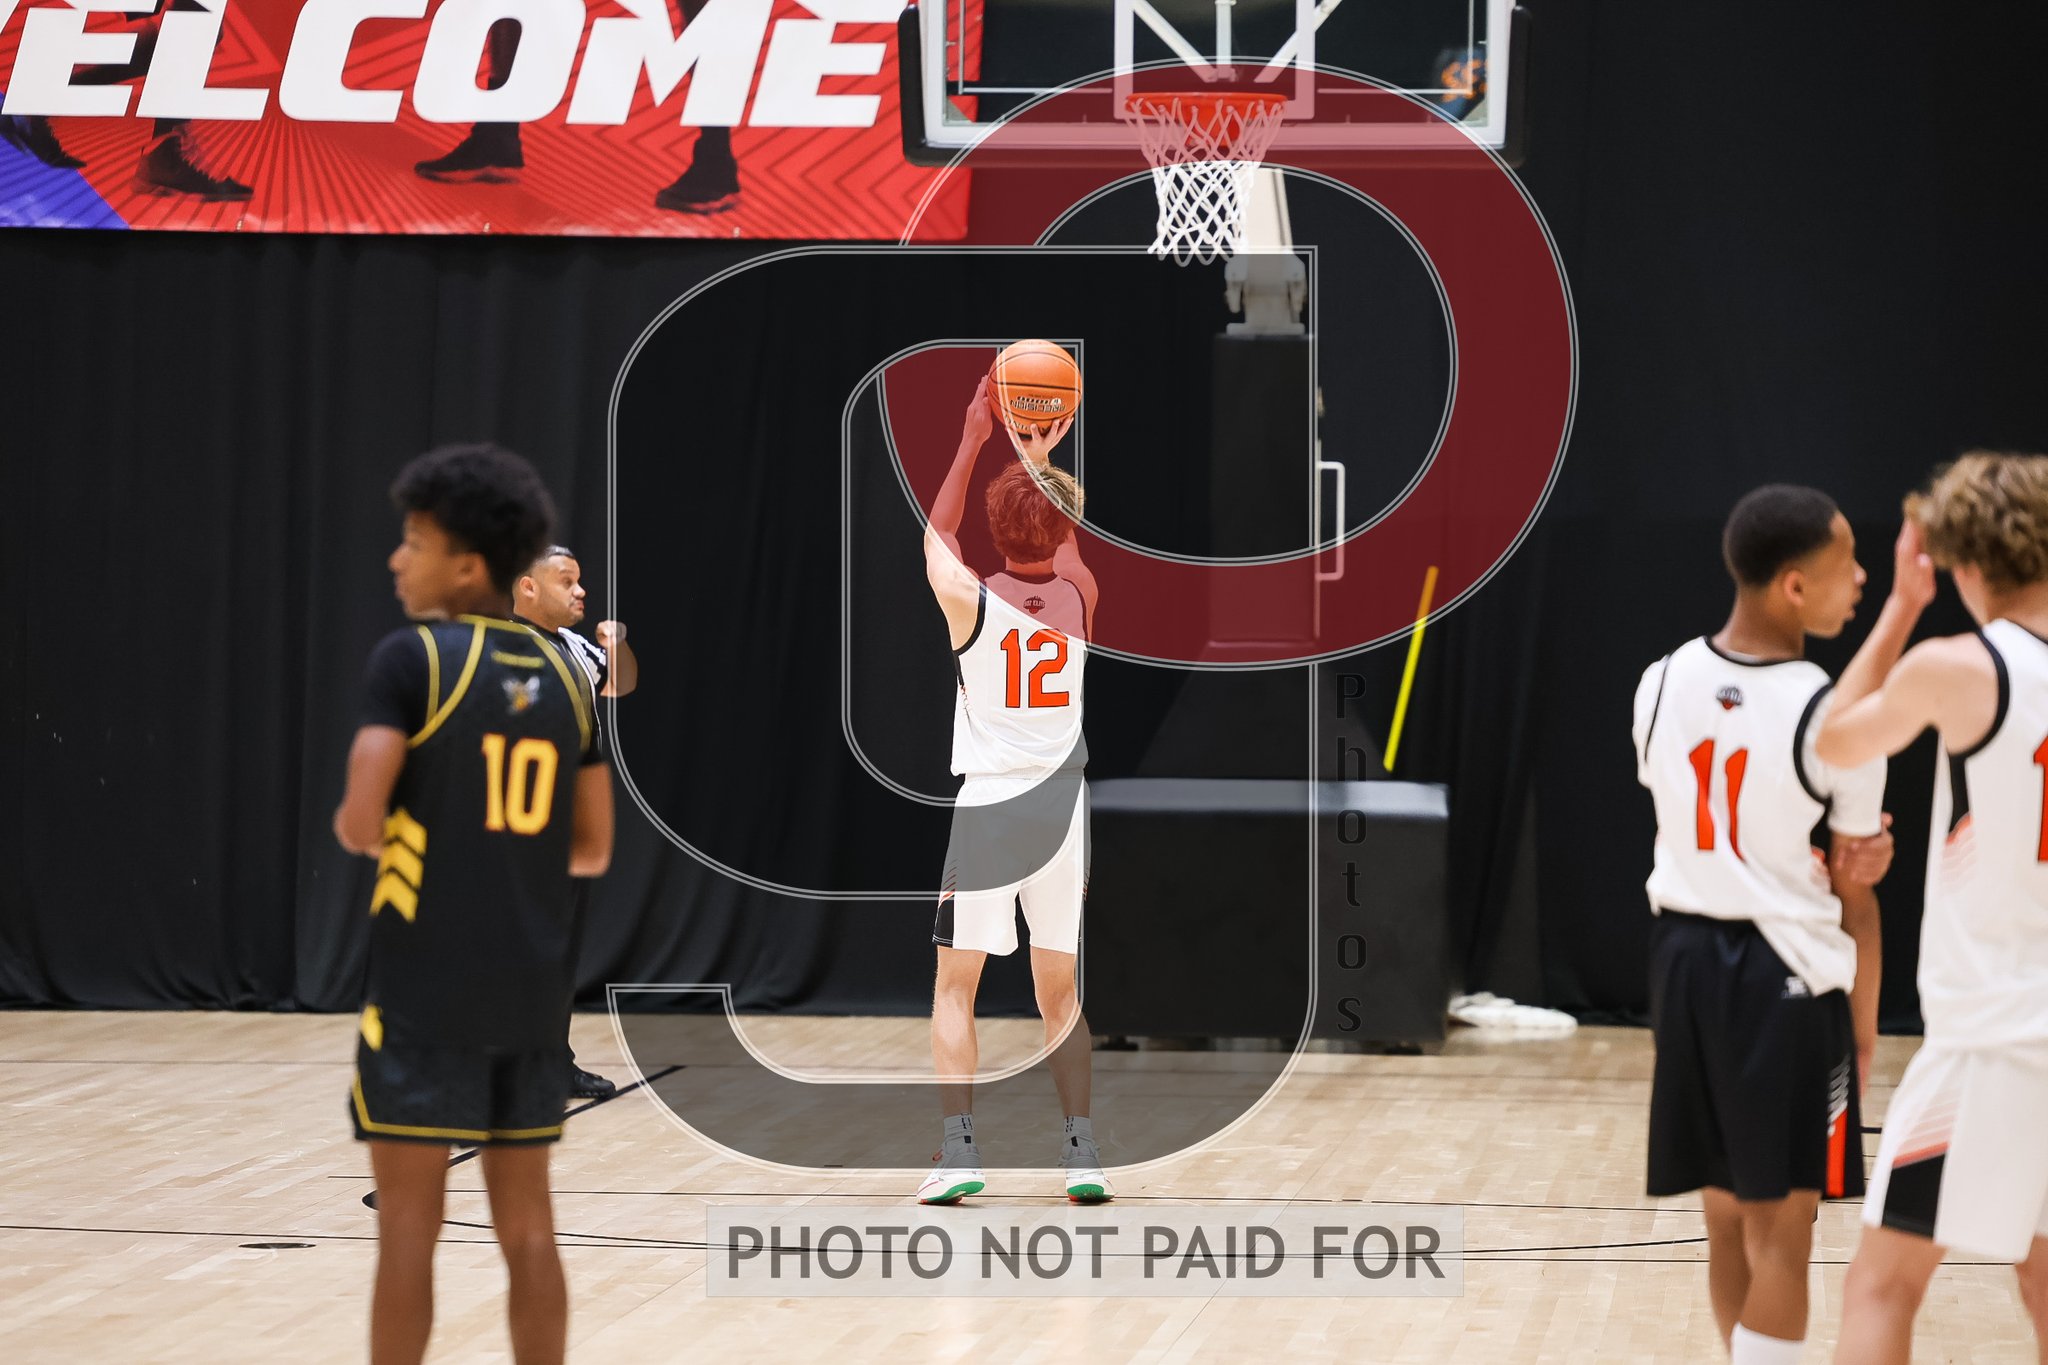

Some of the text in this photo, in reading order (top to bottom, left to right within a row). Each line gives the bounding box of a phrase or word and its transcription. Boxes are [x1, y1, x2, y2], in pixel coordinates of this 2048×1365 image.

[0, 0, 911, 127] ELCOME
[1000, 628, 1070, 708] 12
[482, 732, 559, 836] 10
[1688, 738, 1749, 862] 11
